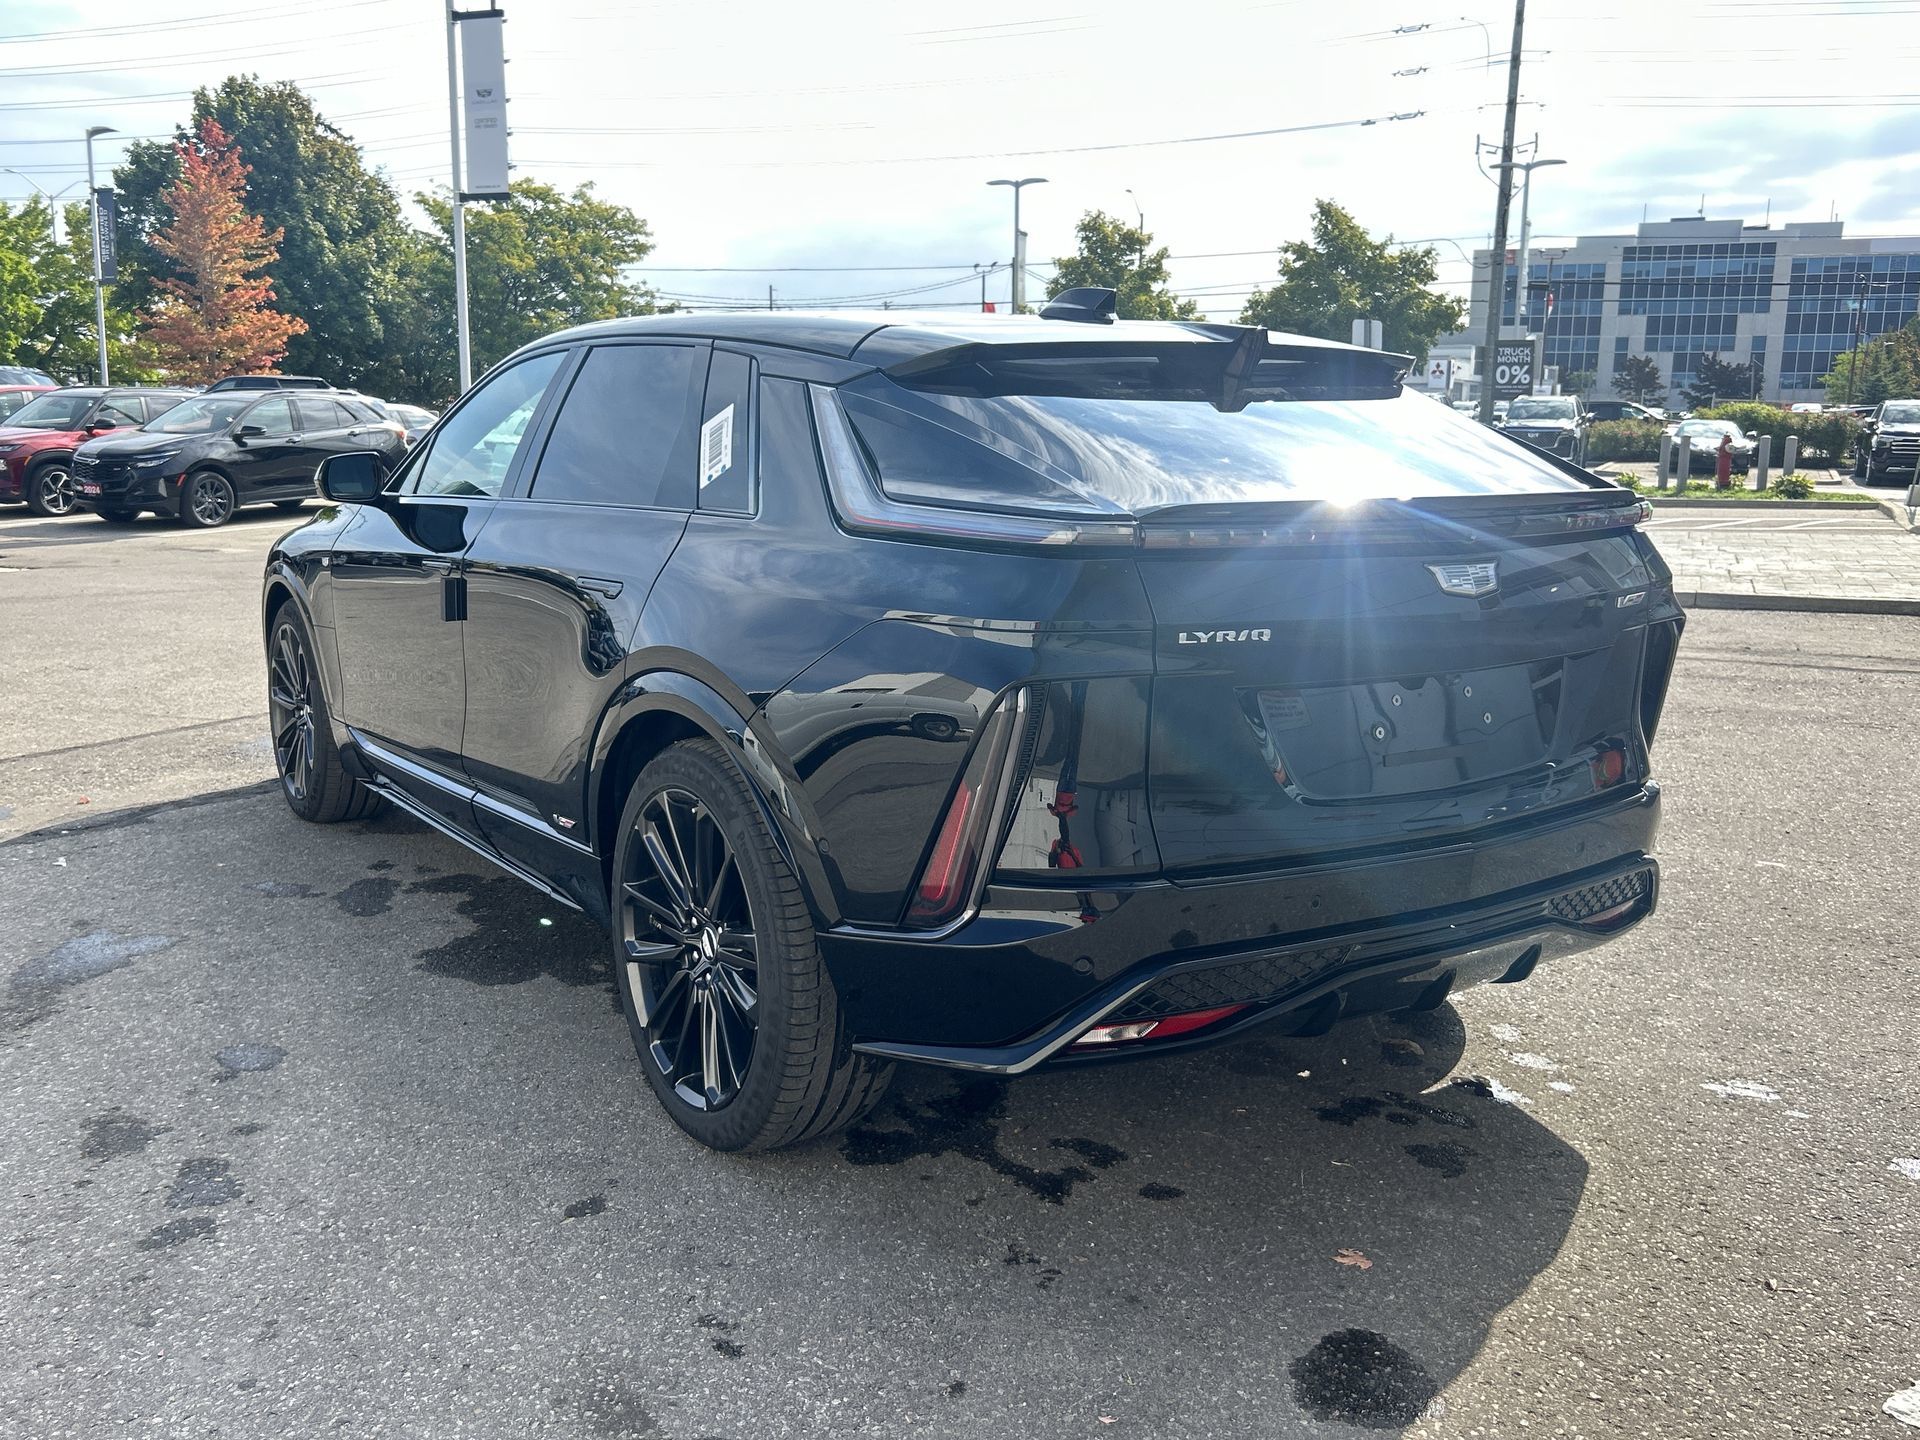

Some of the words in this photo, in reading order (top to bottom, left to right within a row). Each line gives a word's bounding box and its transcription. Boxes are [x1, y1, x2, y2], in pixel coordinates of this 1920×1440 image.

[1498, 347, 1530, 355] TRUCK
[1497, 355, 1530, 363] MONTH
[1495, 365, 1530, 384] 0%
[83, 485, 100, 494] 2024
[1179, 628, 1271, 643] LYRIQ
